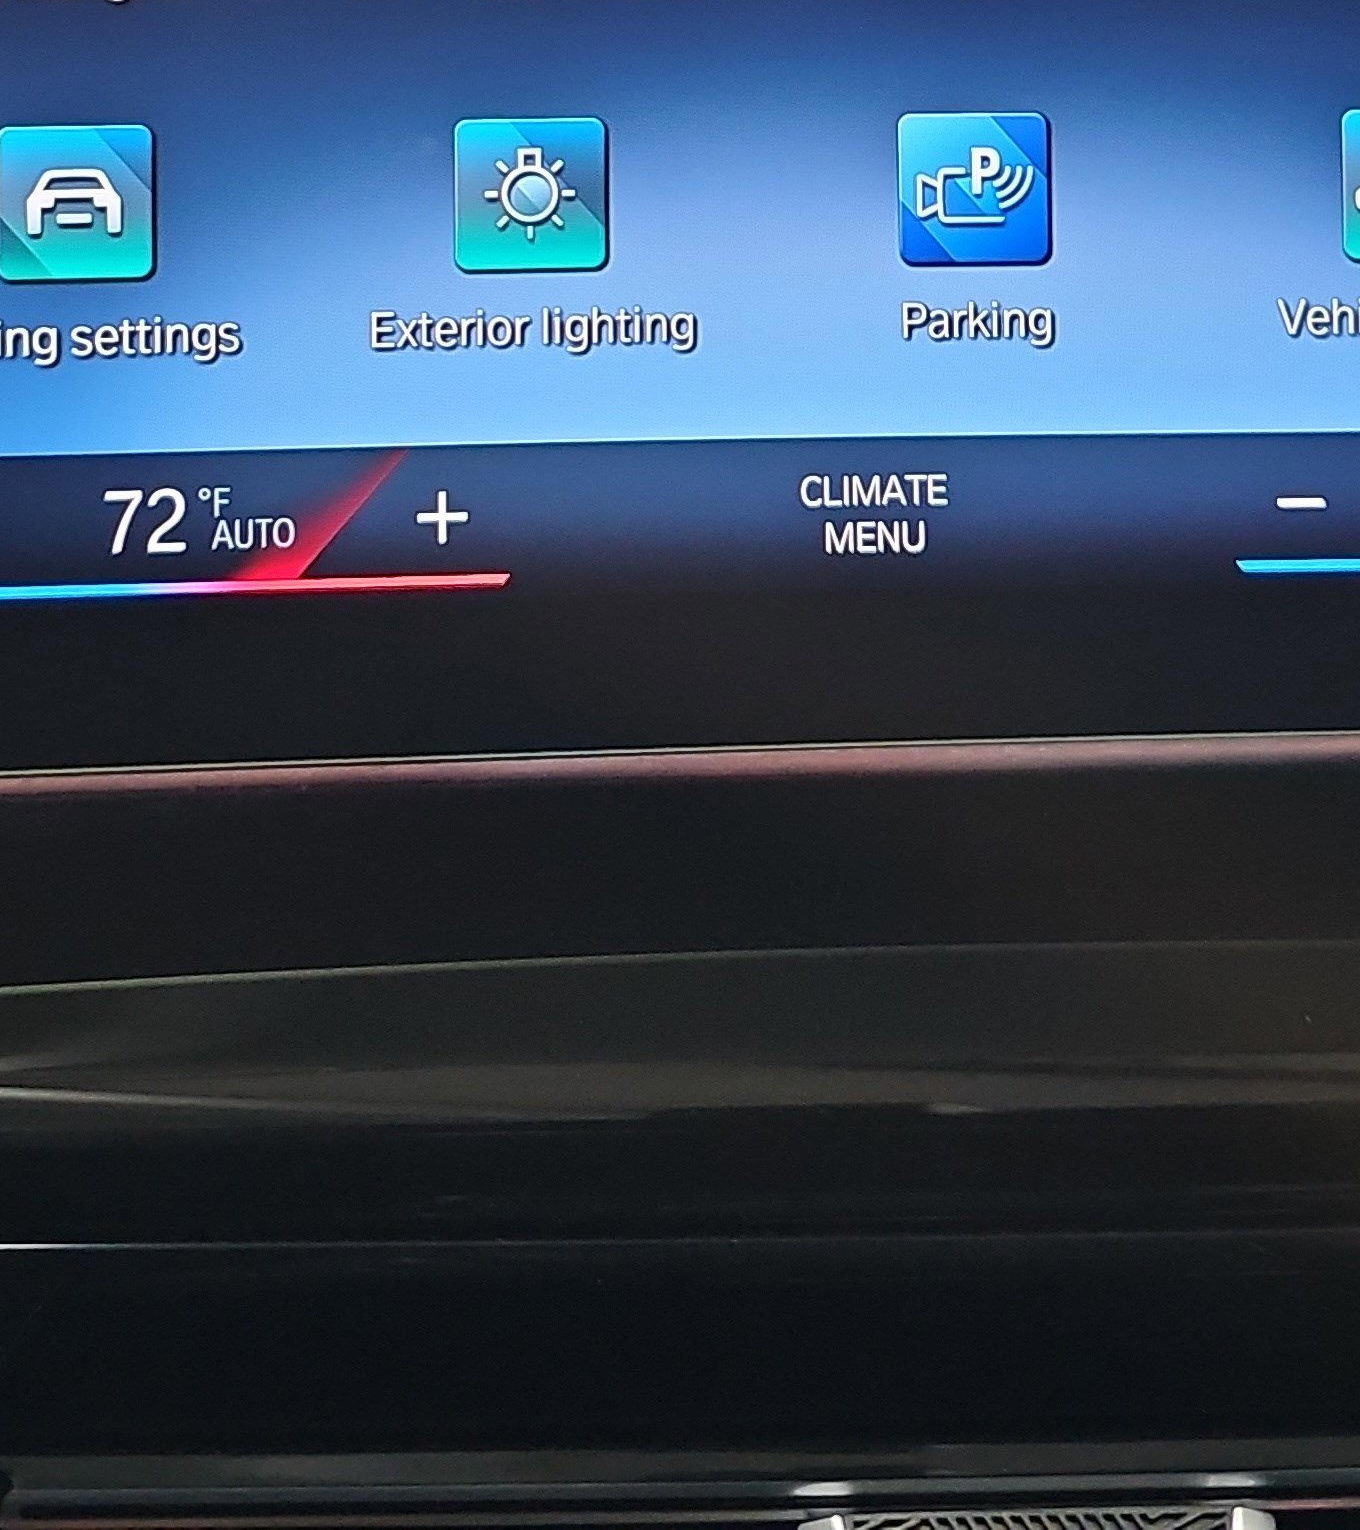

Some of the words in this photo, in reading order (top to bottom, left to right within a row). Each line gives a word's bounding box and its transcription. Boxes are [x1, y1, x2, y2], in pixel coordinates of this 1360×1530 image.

[70, 316, 240, 361] settings
[371, 309, 530, 348] Exterior
[543, 306, 694, 353] lighting
[902, 301, 1052, 346] Parking
[800, 473, 949, 507] CLIMATE
[104, 487, 187, 555] 72
[211, 517, 296, 550] AUTO
[825, 520, 926, 554] MENU
